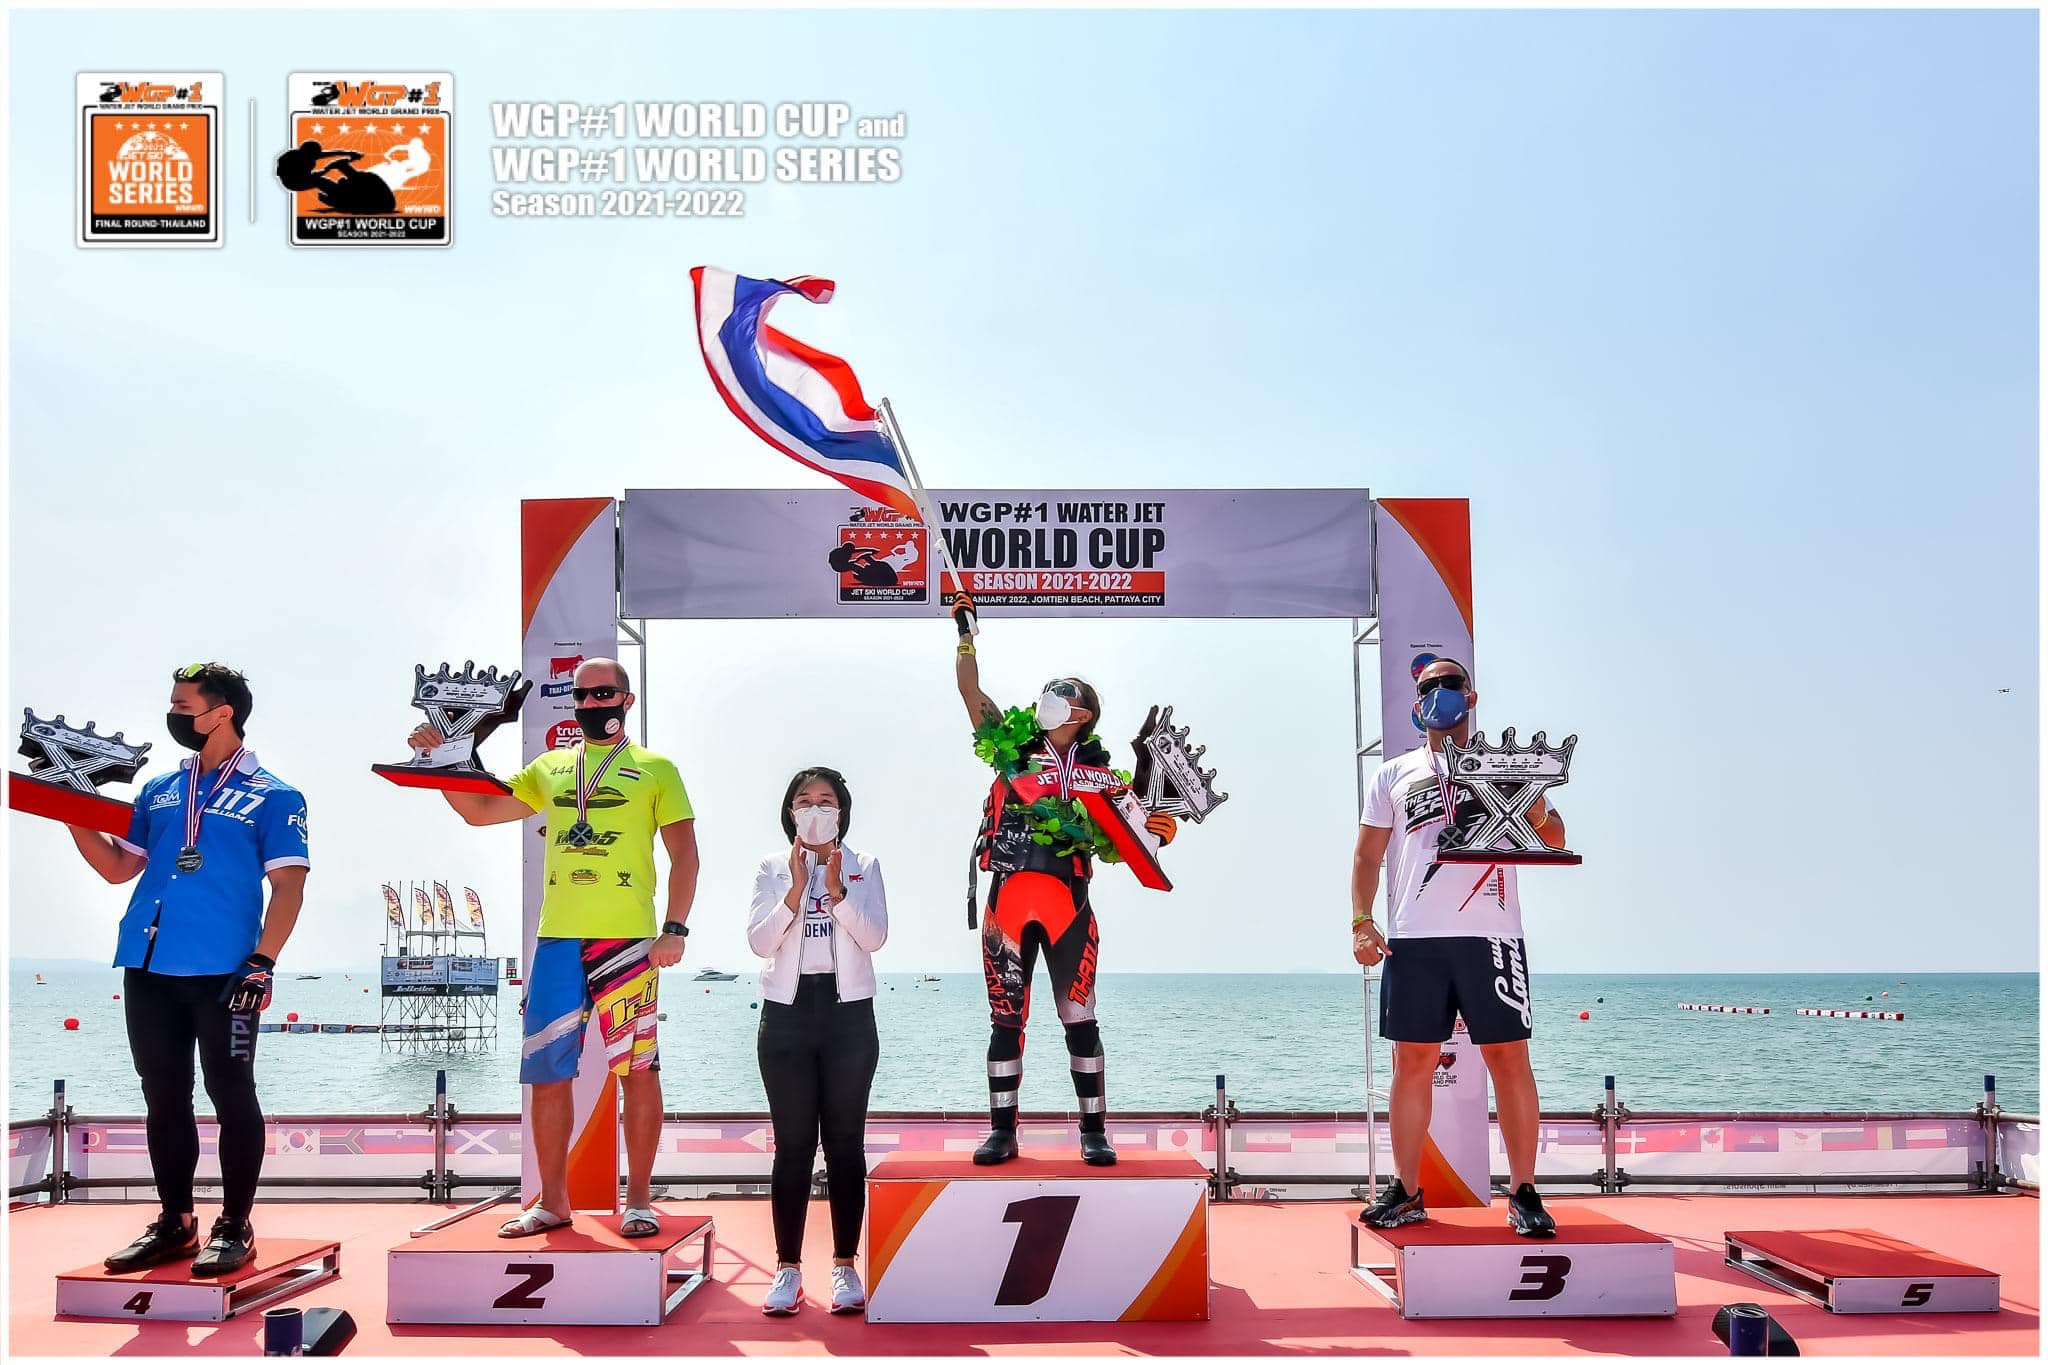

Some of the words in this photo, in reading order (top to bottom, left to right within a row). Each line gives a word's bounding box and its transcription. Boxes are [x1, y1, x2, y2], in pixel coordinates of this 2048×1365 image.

[940, 502, 1048, 522] WGP#1
[1056, 502, 1128, 522] WATER
[1133, 502, 1165, 522] JET
[942, 528, 1077, 569] WORLD
[1088, 528, 1165, 569] CUP
[973, 573, 1038, 590] SEASON
[1041, 573, 1132, 590] 2021-2022
[971, 596, 1007, 604] ANUARY
[1031, 596, 1069, 604] JOMTIEN
[1070, 596, 1102, 605] BEACH,
[1104, 596, 1141, 604] PATTAYA
[1142, 596, 1162, 604] CITY
[556, 726, 583, 737] true
[1037, 772, 1059, 785] JET
[1072, 767, 1085, 780] KI
[1085, 769, 1121, 787] WORLD
[213, 787, 266, 816] 117
[994, 1195, 1081, 1306] 1
[492, 1263, 555, 1309] 2
[1508, 1254, 1573, 1301] 3
[122, 1291, 154, 1315] 4
[1901, 1283, 1934, 1307] 5
